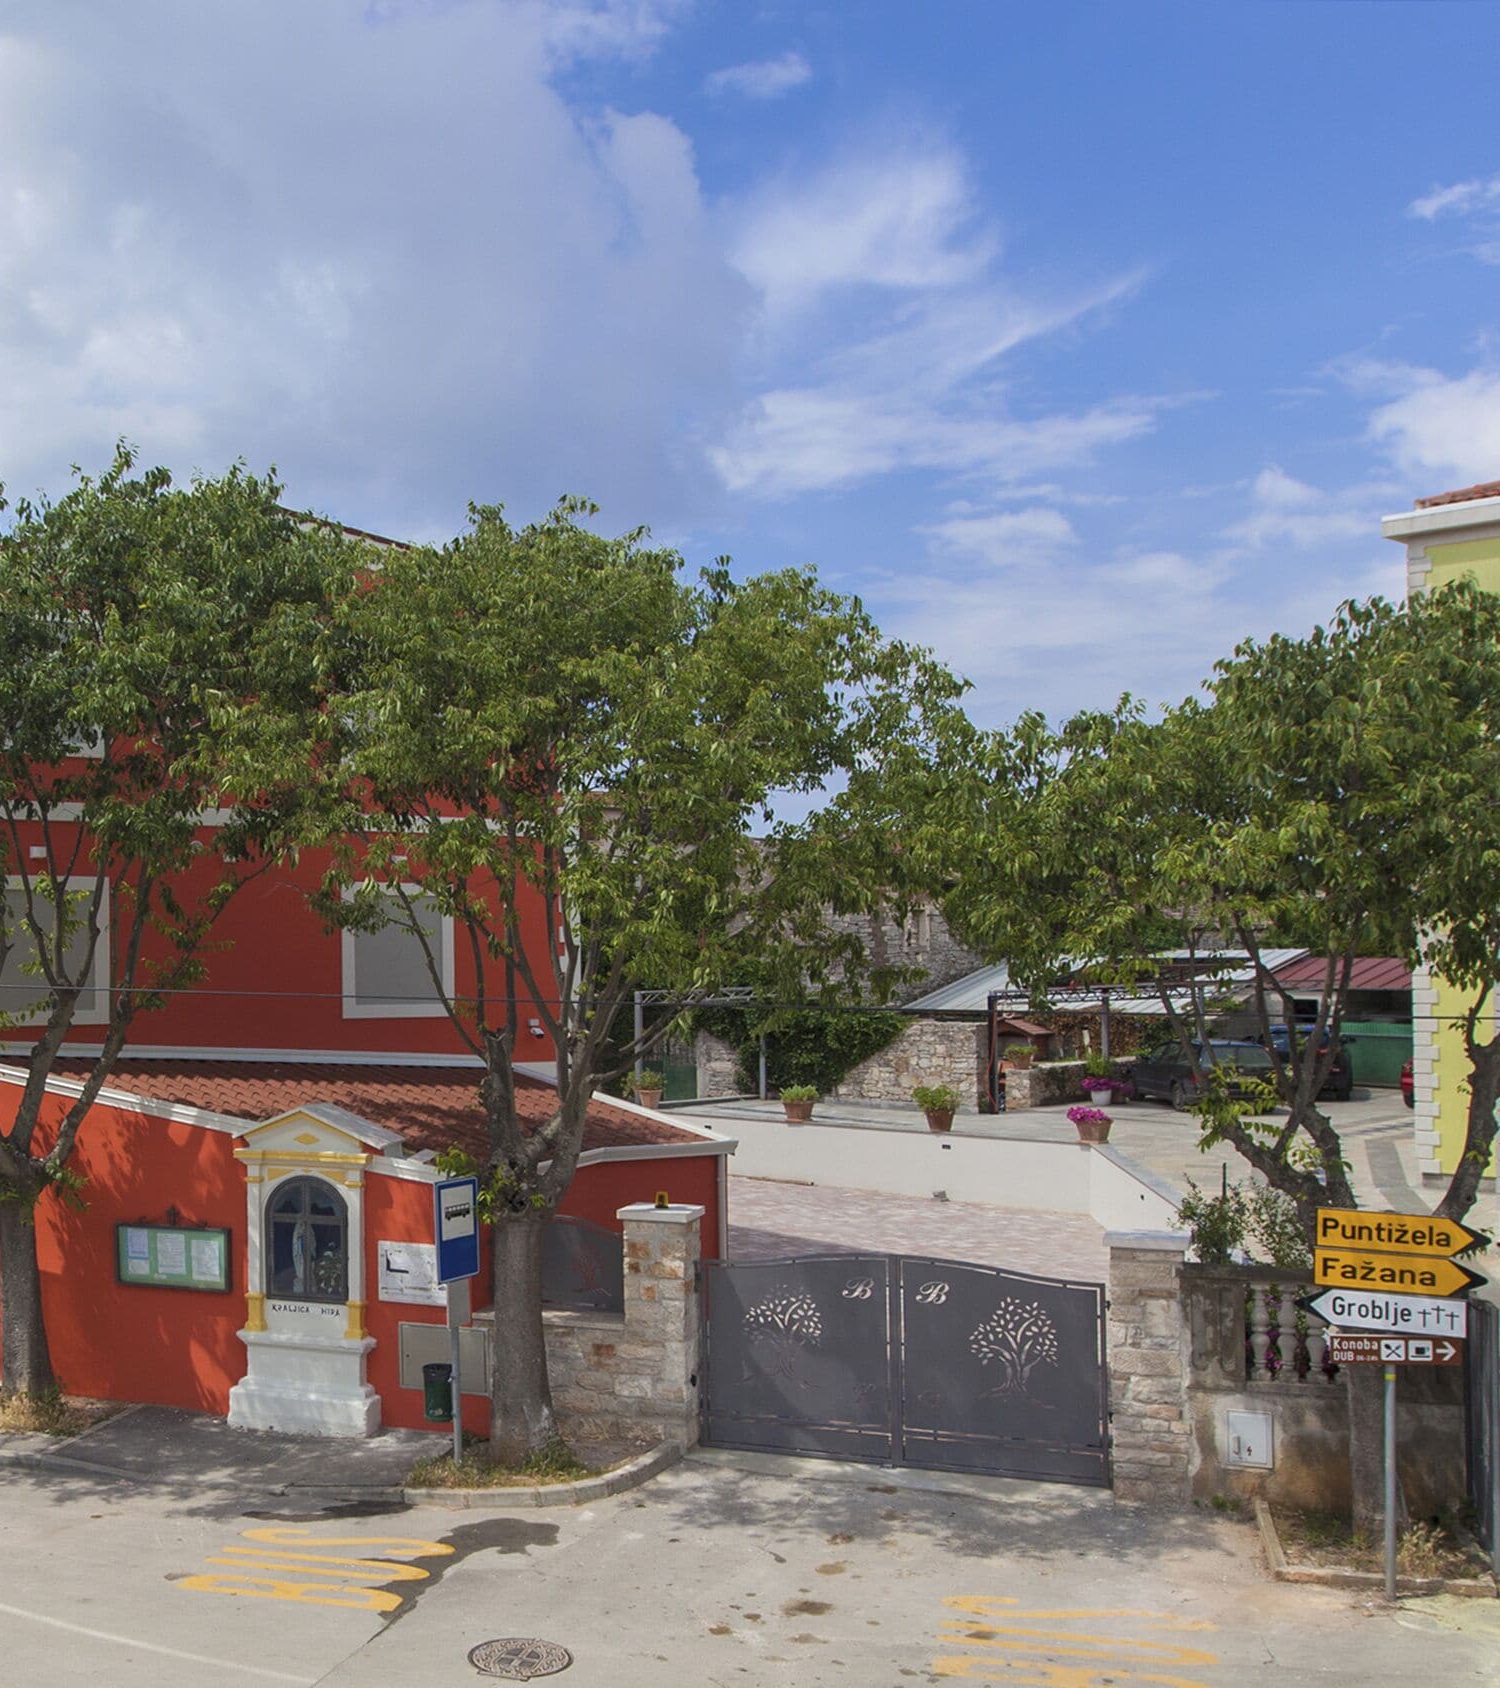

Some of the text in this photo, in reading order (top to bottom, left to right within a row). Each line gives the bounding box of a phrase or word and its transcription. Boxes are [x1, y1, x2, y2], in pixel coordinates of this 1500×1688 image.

[1322, 1217, 1450, 1247] Puntižela
[1322, 1257, 1436, 1286] Fažana
[1332, 1296, 1412, 1326] Groblje
[1333, 1338, 1378, 1349] Konoba
[1333, 1351, 1355, 1361] DUB
[178, 1527, 456, 1612] BUS
